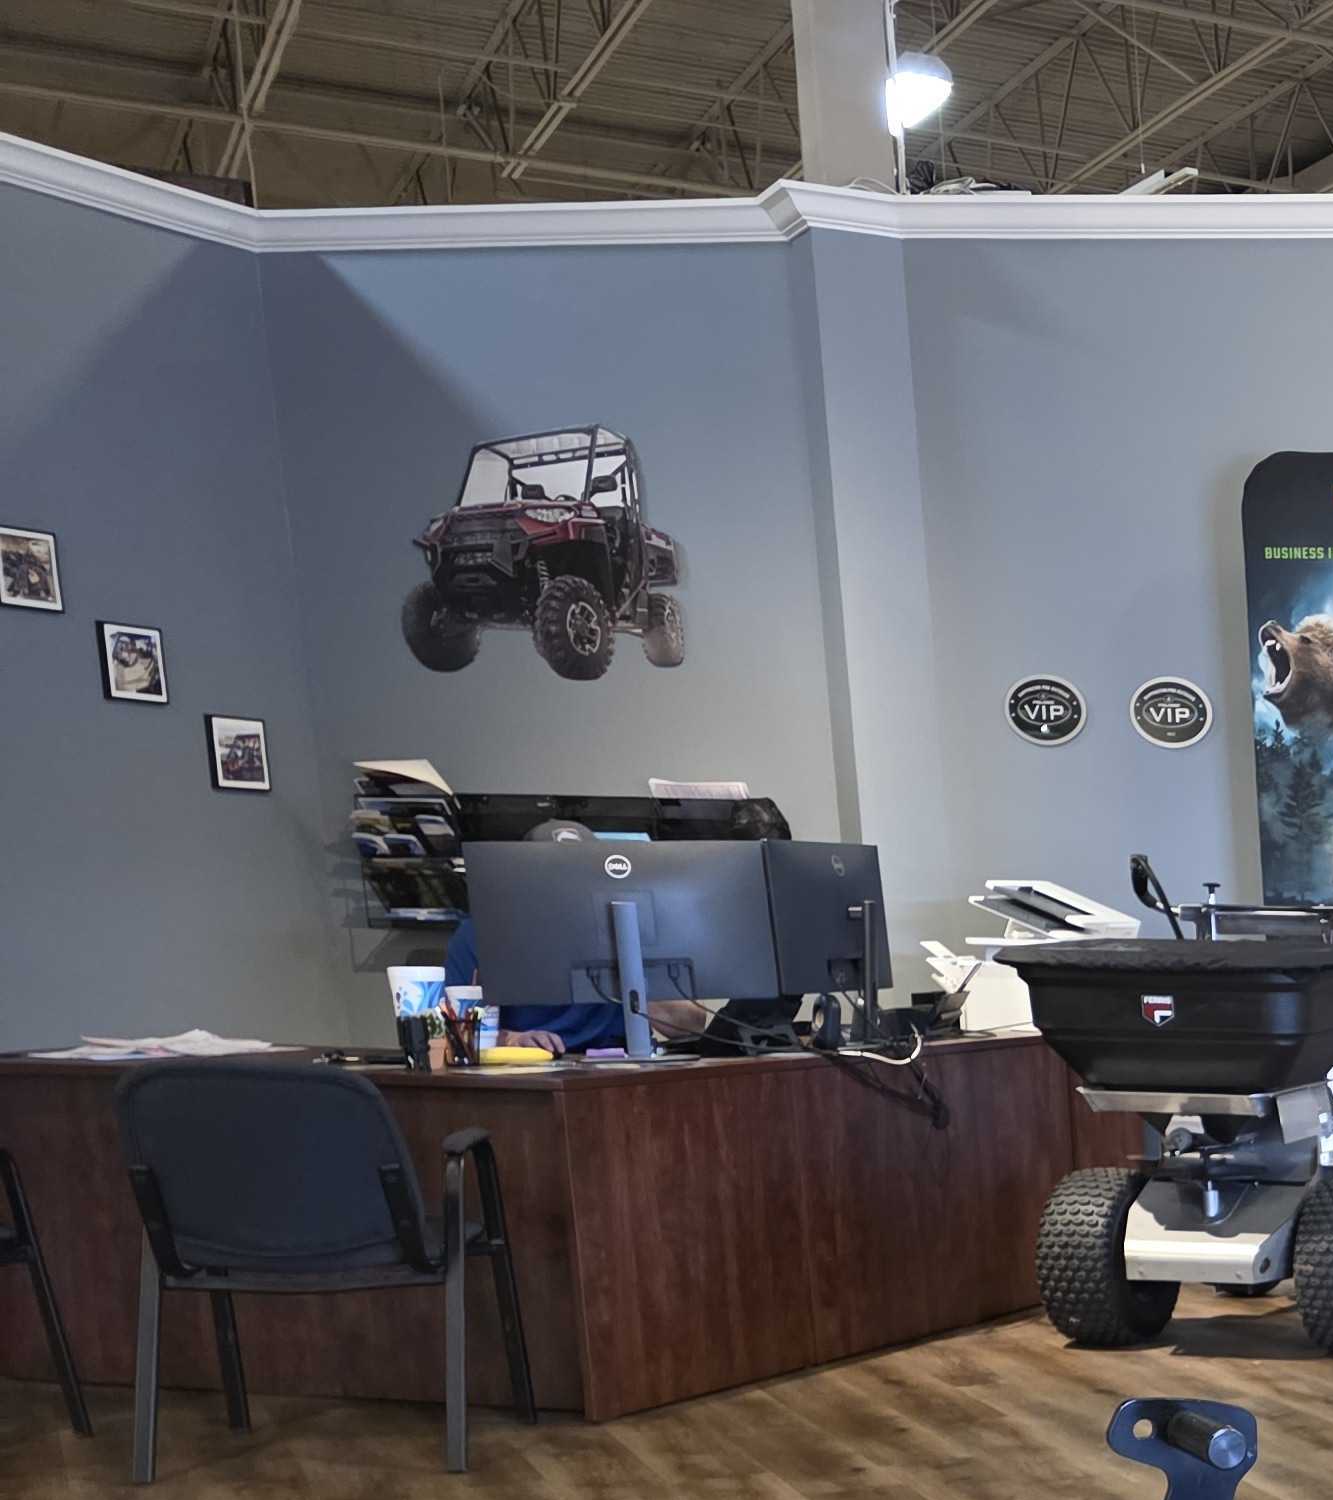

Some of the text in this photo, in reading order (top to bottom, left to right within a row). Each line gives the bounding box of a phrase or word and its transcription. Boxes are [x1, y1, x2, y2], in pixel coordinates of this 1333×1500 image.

[1264, 546, 1324, 560] BUSINESS
[1023, 704, 1065, 720] VIP
[1149, 707, 1191, 723] VIP
